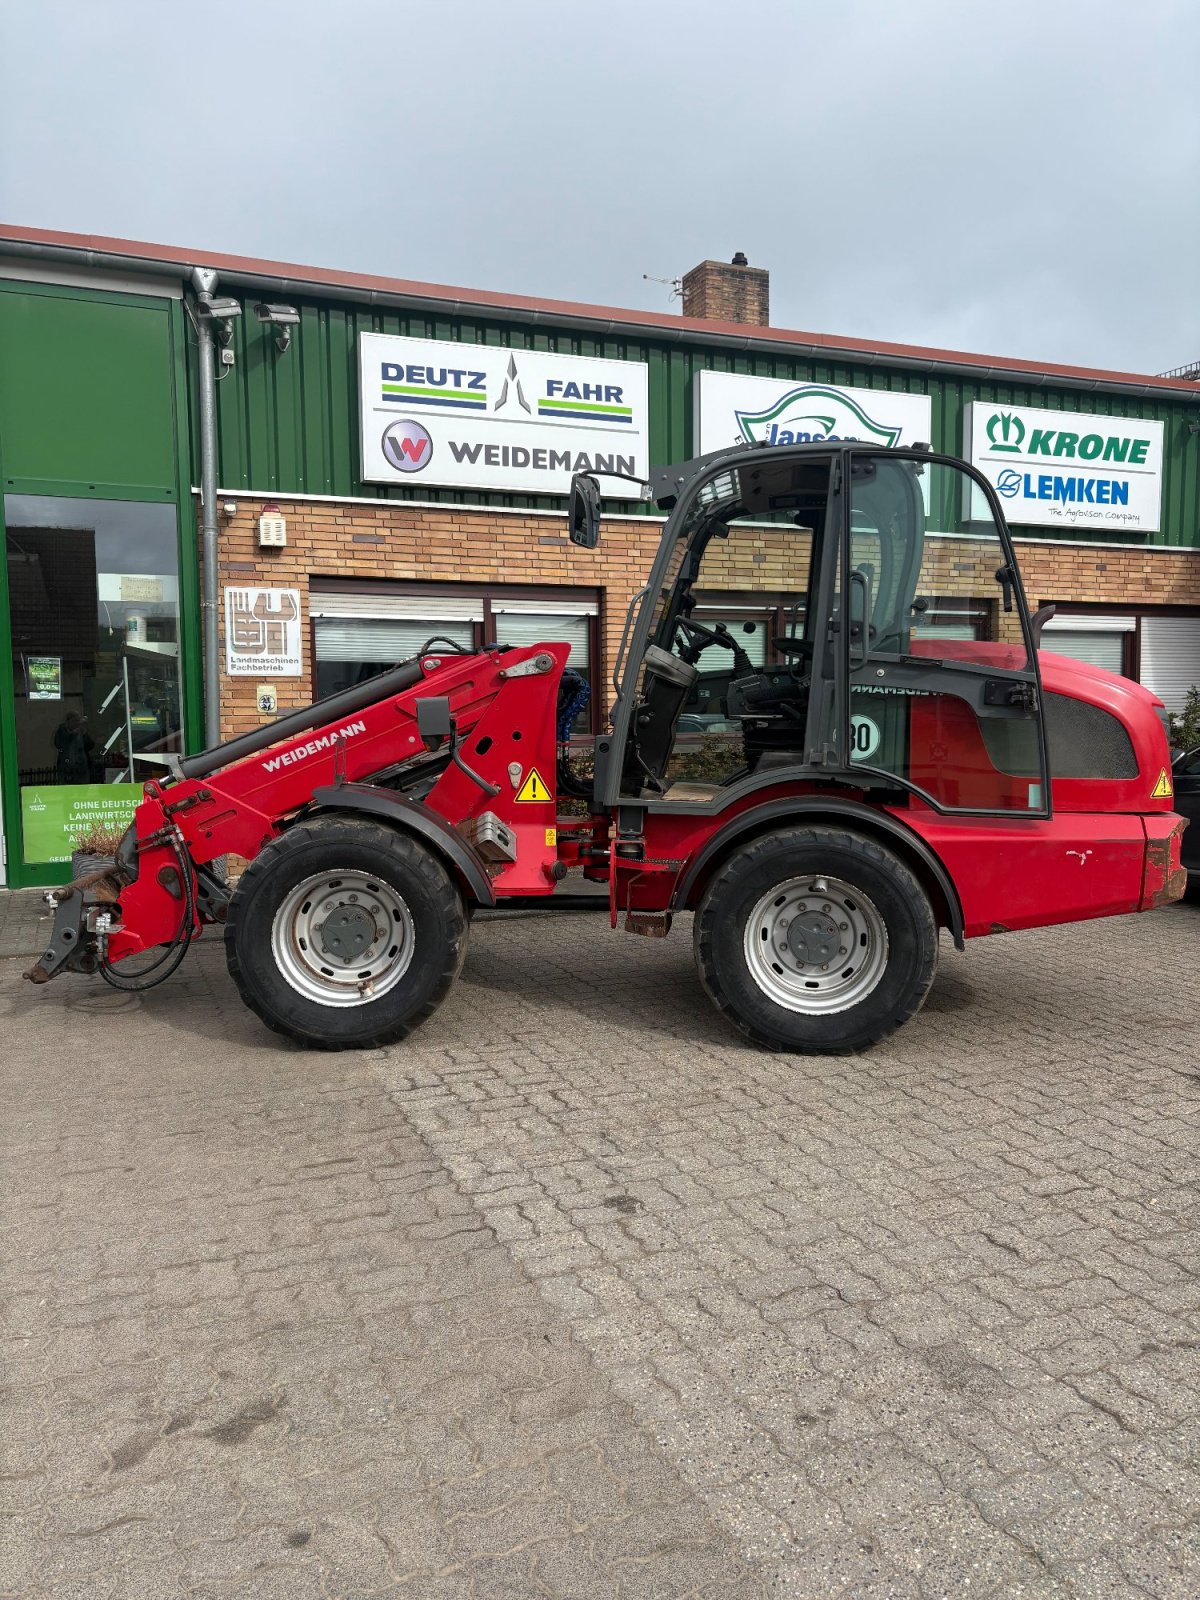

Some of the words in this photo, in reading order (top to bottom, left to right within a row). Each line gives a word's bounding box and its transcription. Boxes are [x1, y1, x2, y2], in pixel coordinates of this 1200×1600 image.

[381, 362, 487, 390] DEUTZ
[546, 379, 623, 404] FAHR
[1027, 429, 1151, 464] KRONE
[448, 441, 635, 476] WEIDEMANN
[1024, 474, 1129, 507] LEMKEN
[1048, 508, 1063, 516] The
[230, 656, 299, 665] Landmaschinen
[230, 664, 284, 672] Fachbetrieb
[261, 720, 367, 773] WEIDEMANN
[73, 801, 100, 809] OHNE
[63, 823, 92, 831] KEINE
